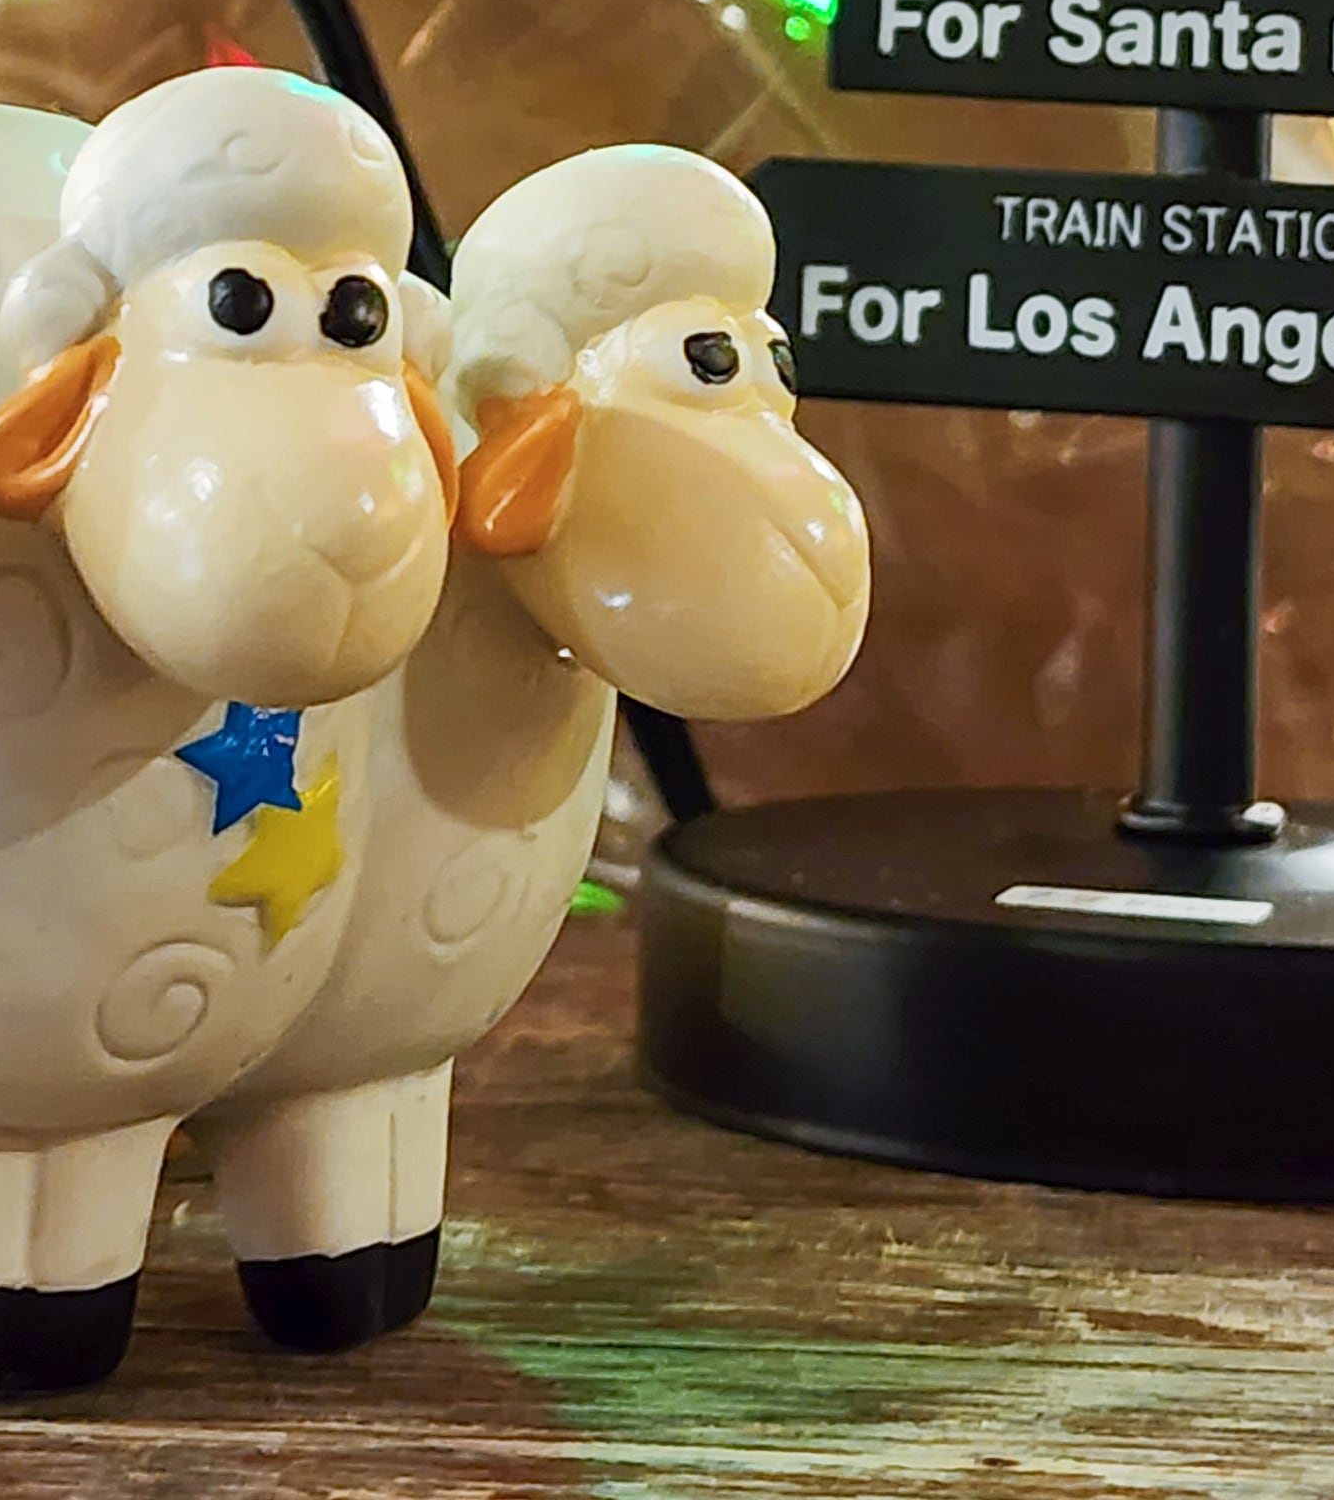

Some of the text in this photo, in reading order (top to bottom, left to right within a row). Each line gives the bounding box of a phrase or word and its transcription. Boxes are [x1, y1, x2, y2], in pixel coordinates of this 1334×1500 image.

[994, 195, 1143, 249] TRAIN
[800, 264, 943, 344] For
[967, 272, 1117, 358] Los
